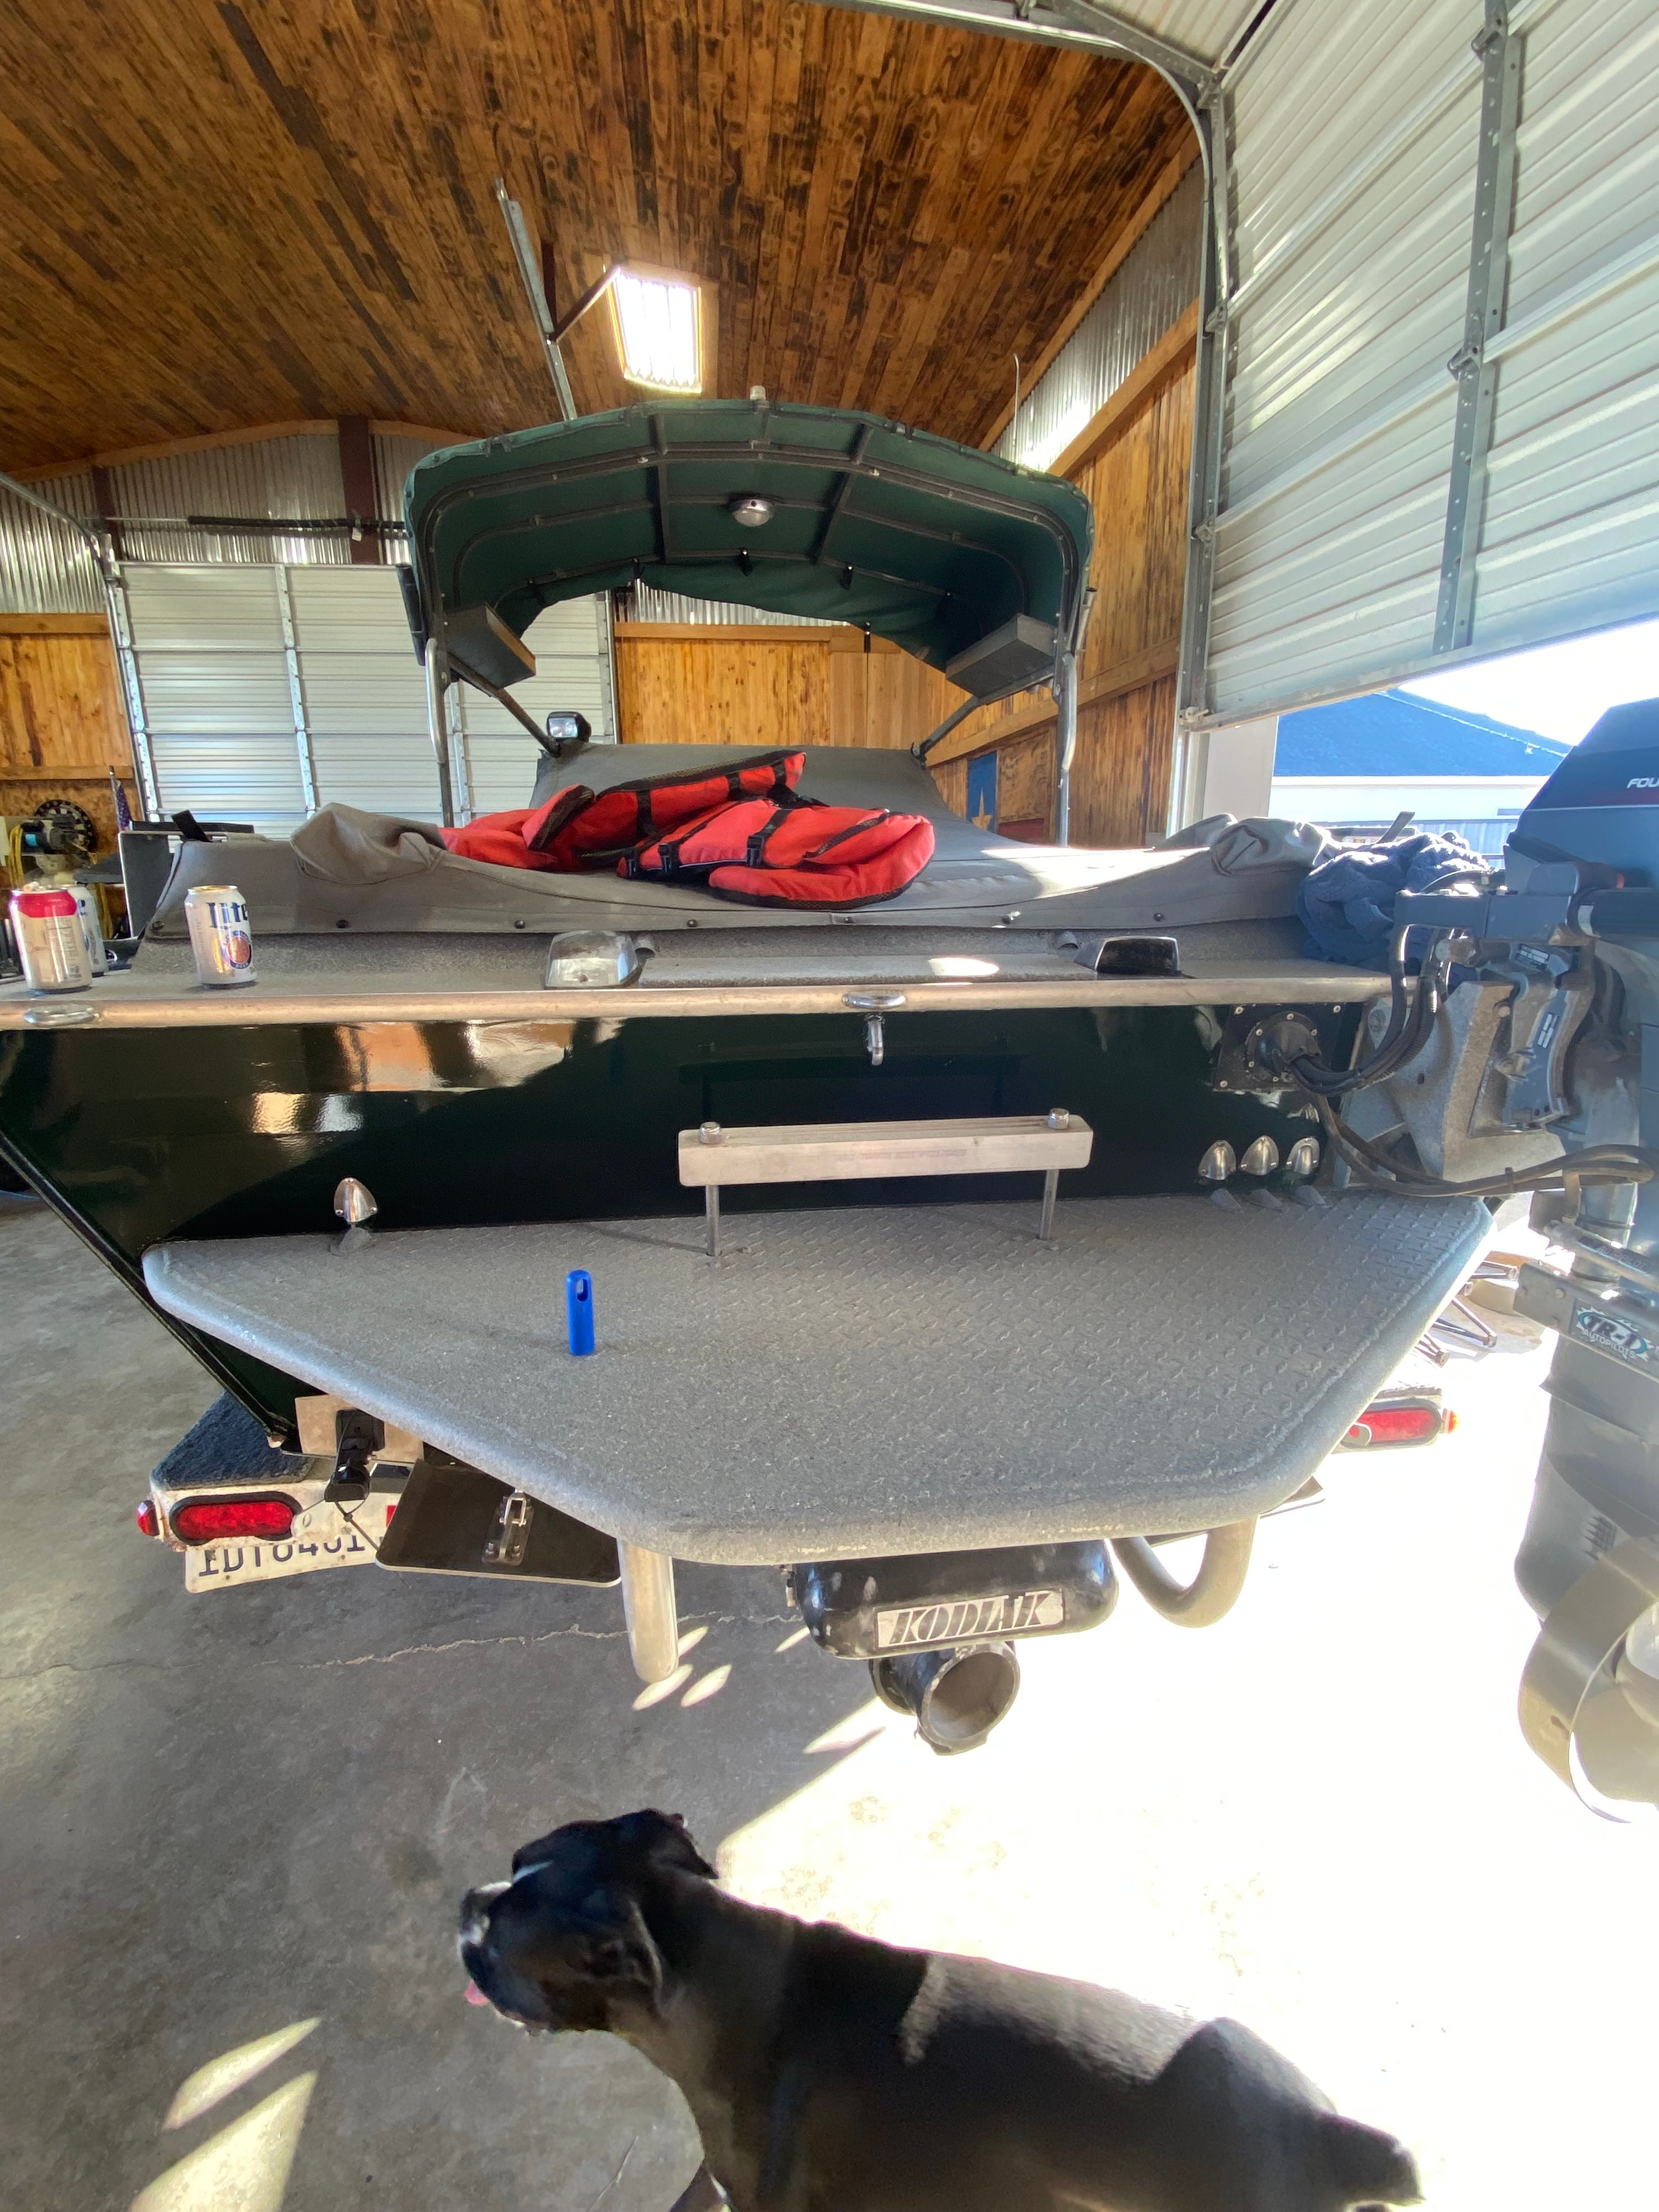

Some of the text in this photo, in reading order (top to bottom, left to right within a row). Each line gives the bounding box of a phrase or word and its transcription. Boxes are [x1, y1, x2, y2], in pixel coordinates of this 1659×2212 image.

[1581, 1328, 1637, 1359] AUTOPILOTS
[1585, 1316, 1638, 1347] TR-1
[889, 1593, 1052, 1645] KODIAK
